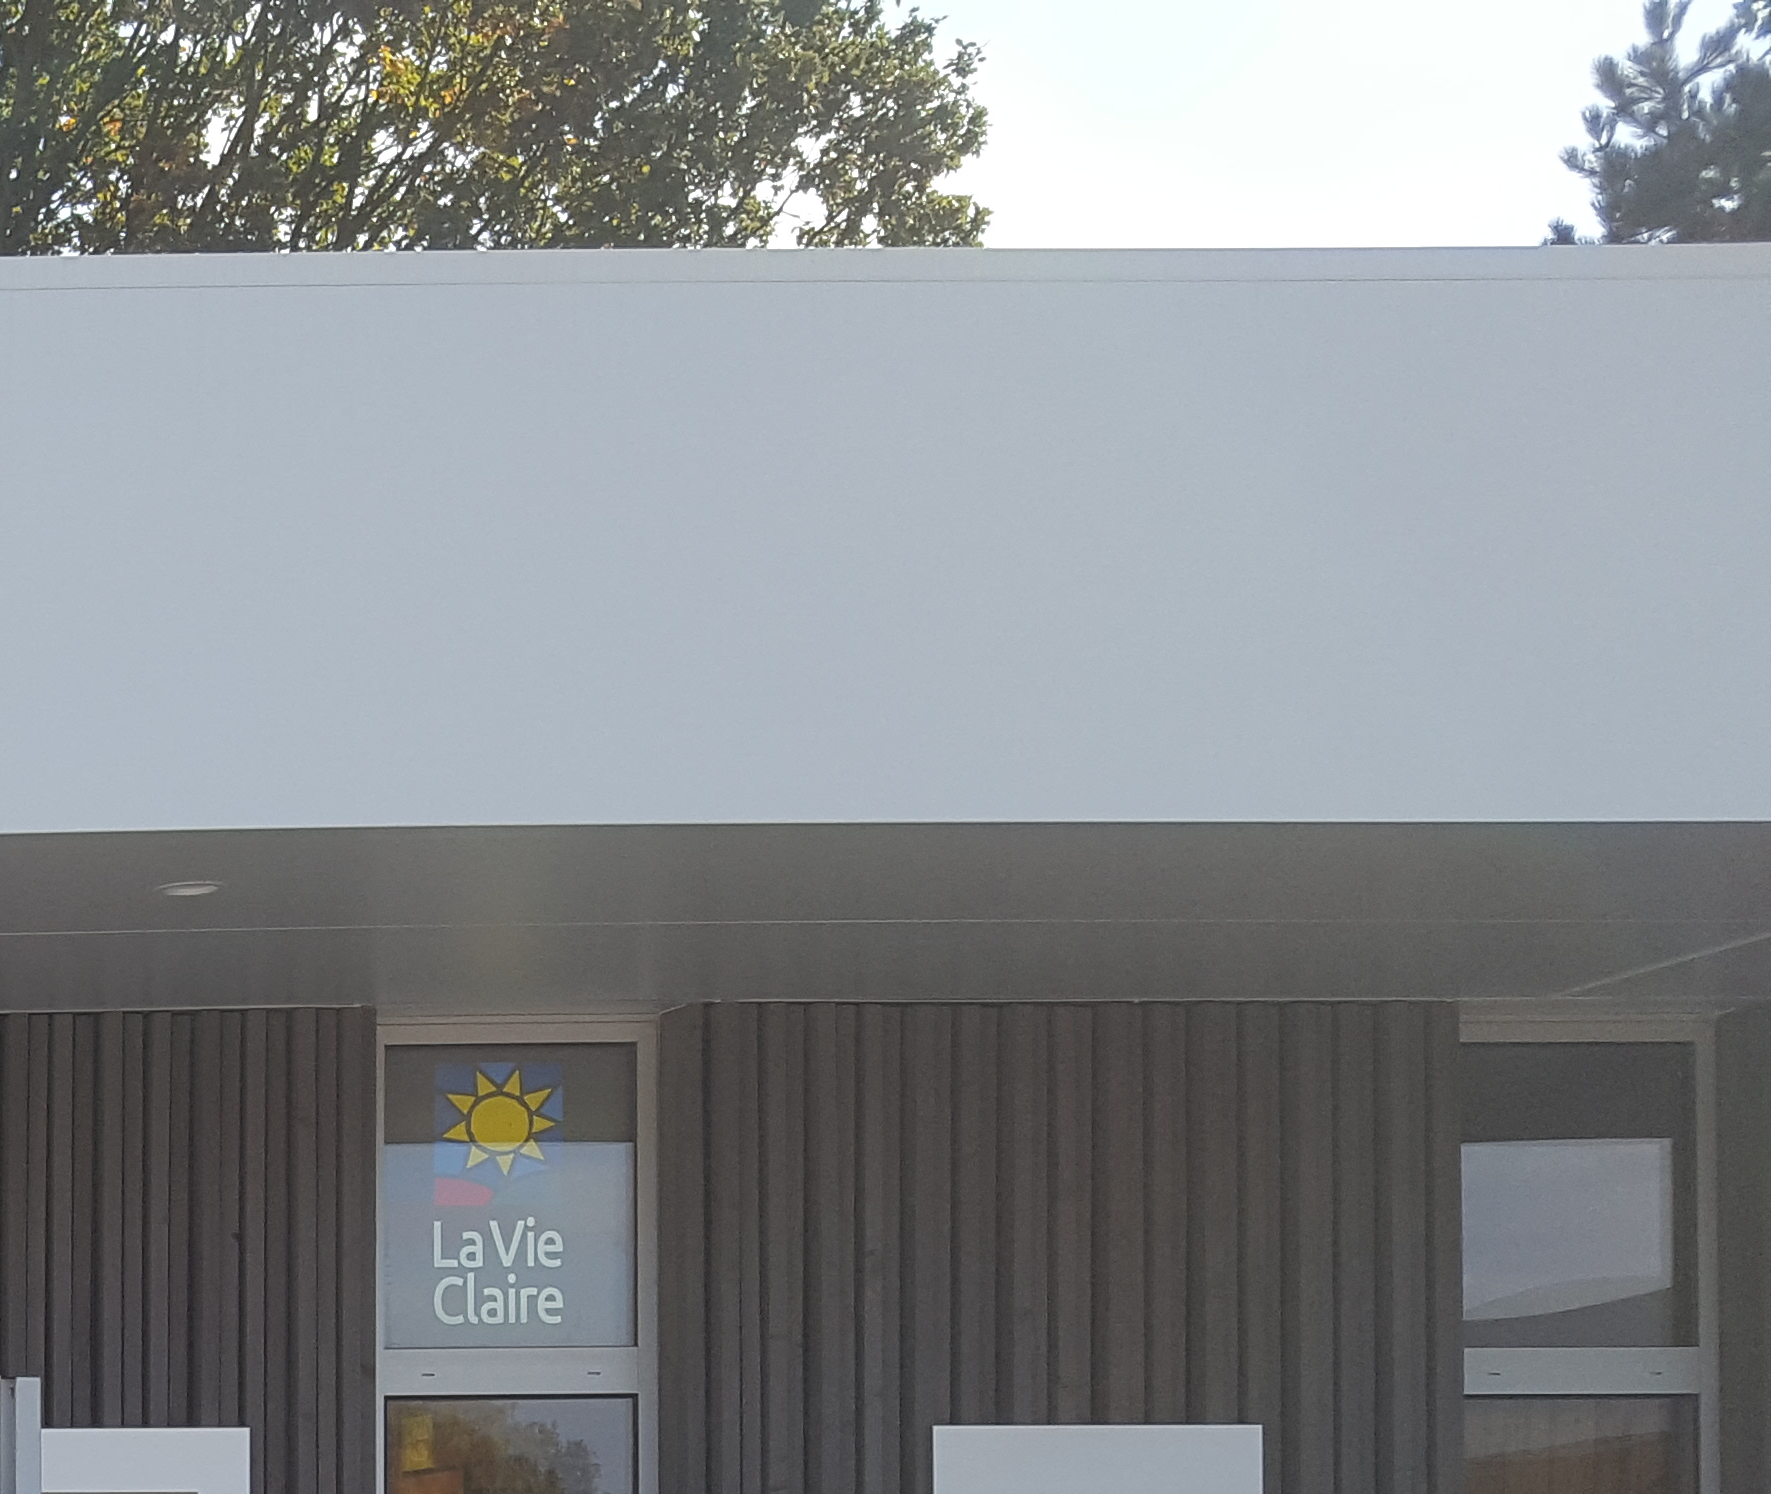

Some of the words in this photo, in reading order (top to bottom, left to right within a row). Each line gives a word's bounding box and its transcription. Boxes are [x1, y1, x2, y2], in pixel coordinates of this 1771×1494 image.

[433, 1220, 484, 1268] La
[489, 1217, 564, 1268] Vie
[434, 1273, 564, 1325] Claire
